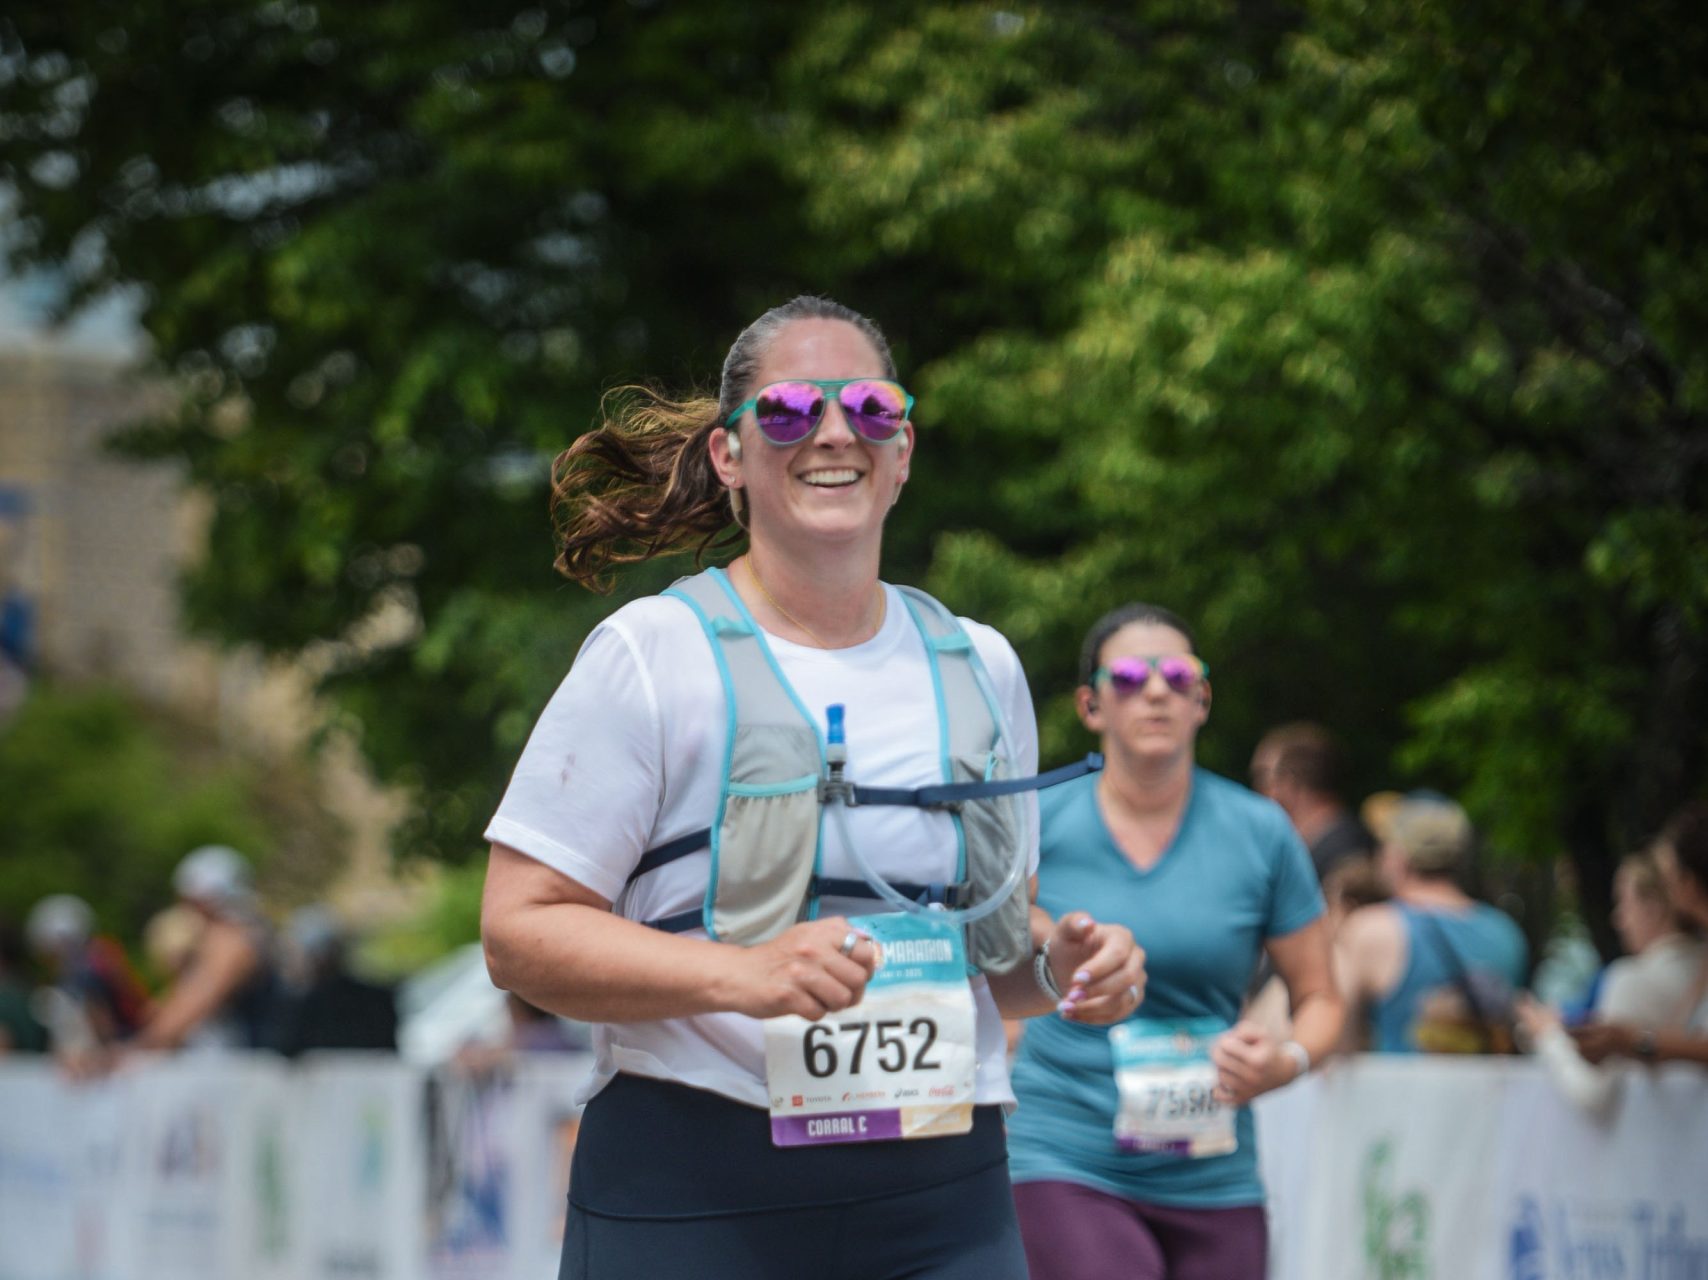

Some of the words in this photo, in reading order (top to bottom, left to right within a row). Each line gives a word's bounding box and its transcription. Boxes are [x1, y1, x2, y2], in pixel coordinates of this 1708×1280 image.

[882, 939, 953, 963] MARATHON
[803, 1017, 941, 1078] 6752
[807, 1117, 855, 1137] CORRAL
[858, 1115, 868, 1133] C
